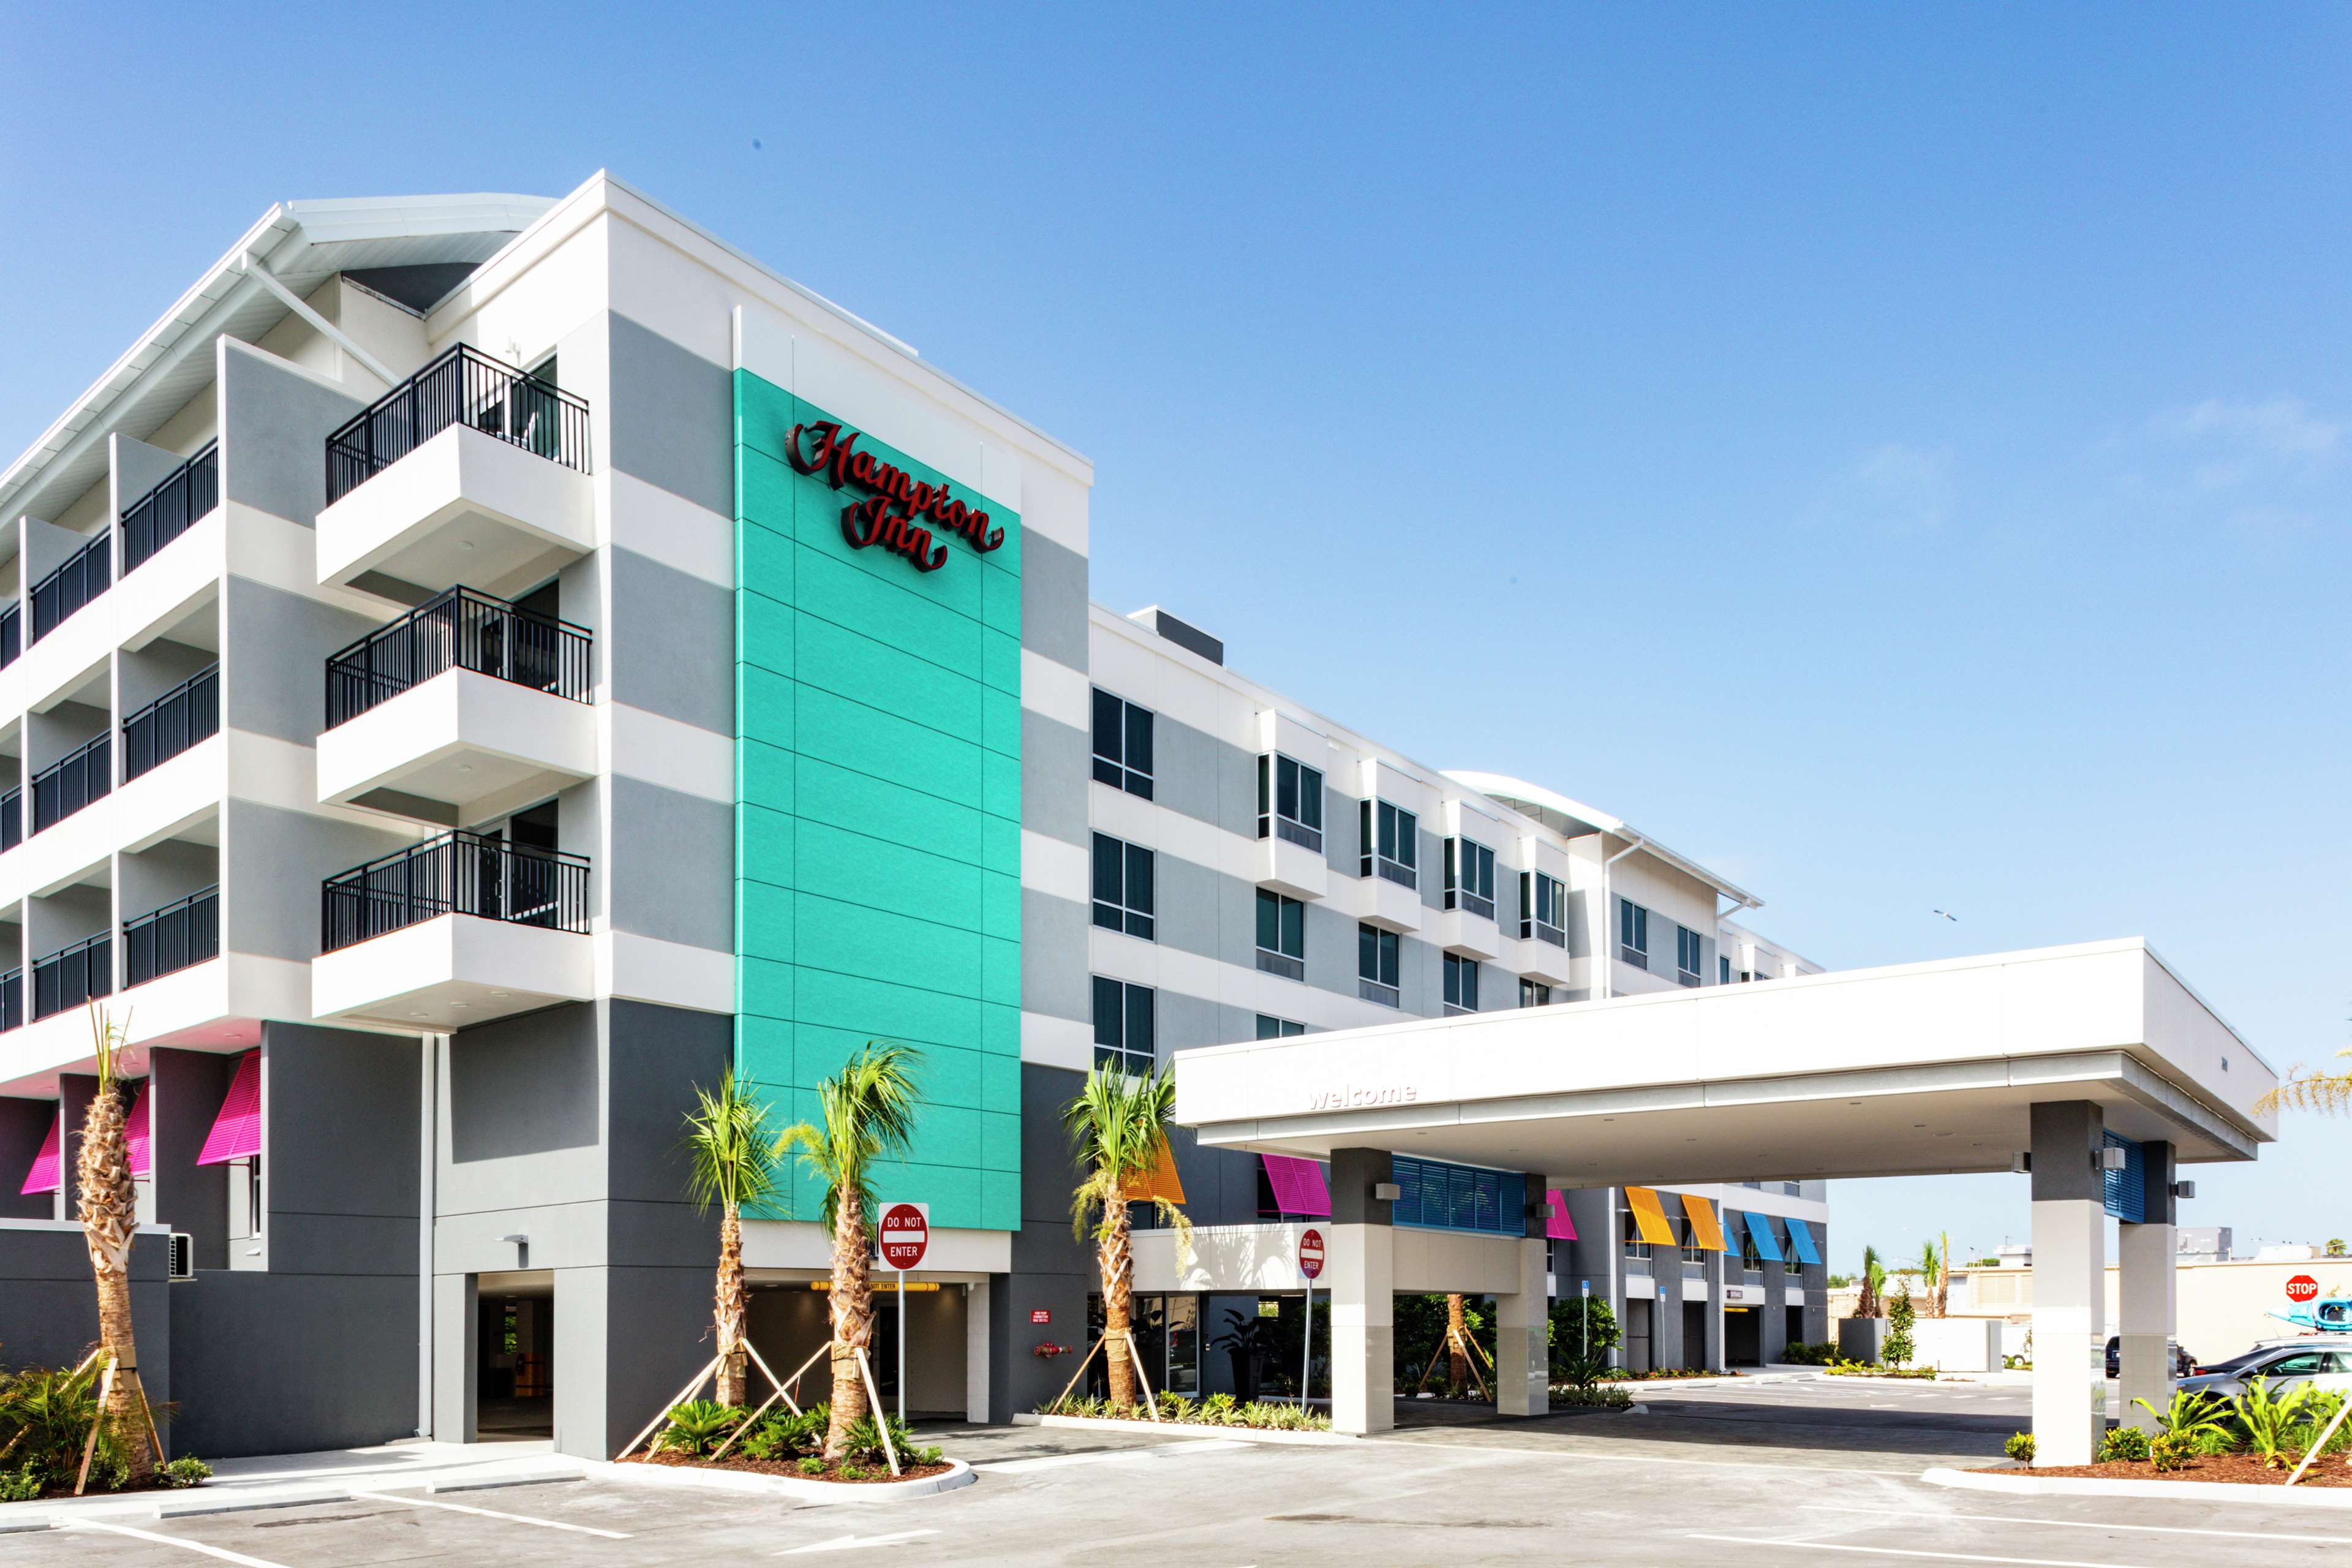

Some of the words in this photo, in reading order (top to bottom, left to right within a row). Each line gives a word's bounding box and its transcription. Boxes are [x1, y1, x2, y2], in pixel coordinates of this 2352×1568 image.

[785, 420, 1004, 552] Hampton
[840, 495, 948, 573] Inn
[1310, 1084, 1417, 1110] welcome
[888, 1217, 899, 1227] DO
[905, 1217, 921, 1227] NOT
[891, 1246, 918, 1257] ENTER
[1304, 1261, 1319, 1269] ENTER
[2287, 1283, 2316, 1294] STOP
